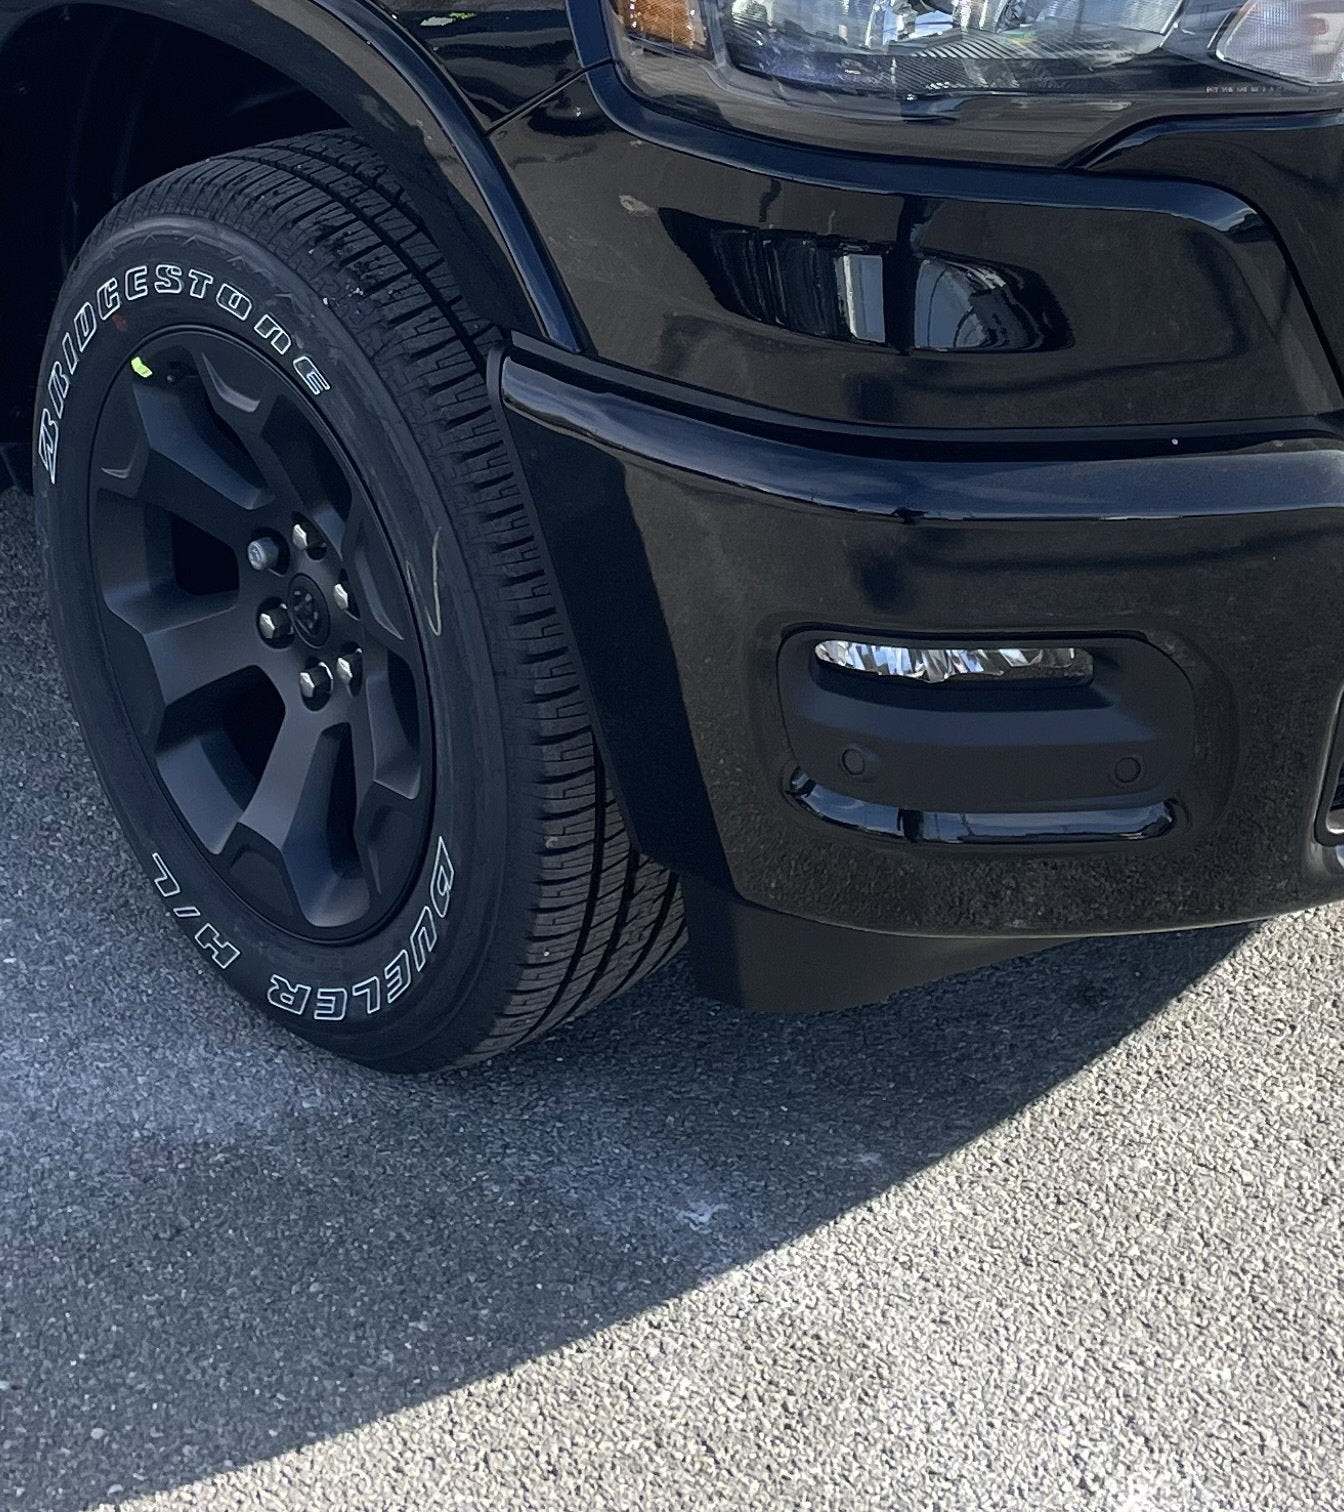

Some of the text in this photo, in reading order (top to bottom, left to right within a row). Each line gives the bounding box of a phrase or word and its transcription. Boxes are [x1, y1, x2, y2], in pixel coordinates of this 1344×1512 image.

[38, 263, 332, 486] BRIDGESTONE
[150, 835, 457, 1022] DUELER H/L
